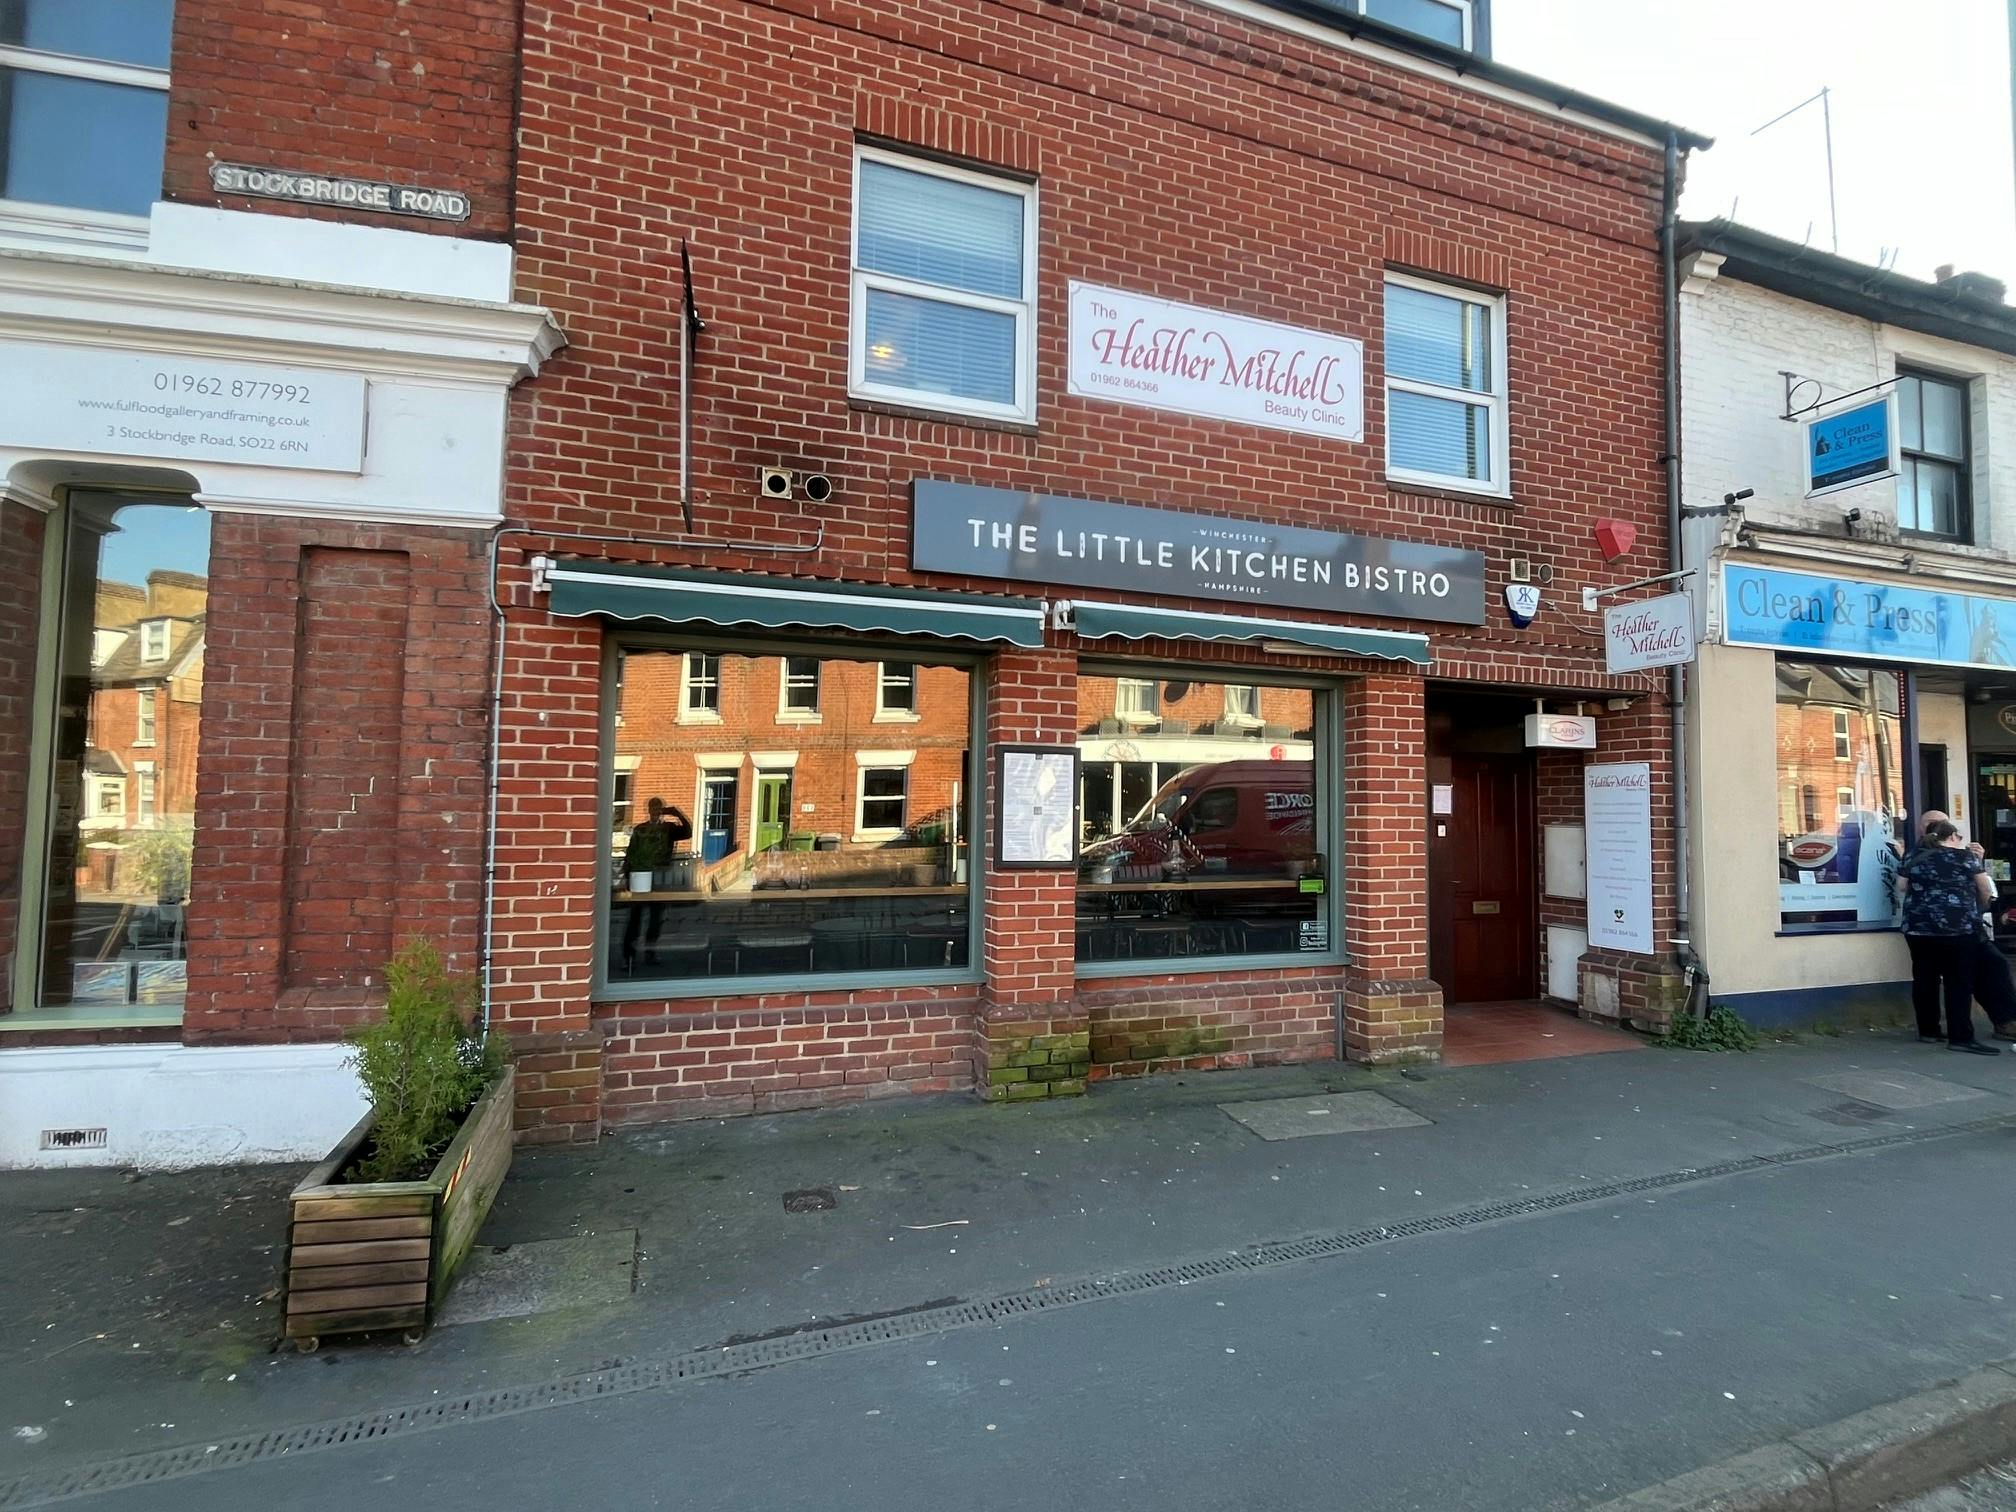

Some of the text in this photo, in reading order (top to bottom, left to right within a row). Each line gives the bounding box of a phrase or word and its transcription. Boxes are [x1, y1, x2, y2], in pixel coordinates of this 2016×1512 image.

[214, 168, 464, 216] STOCKBRIDGE ROAD
[1091, 302, 1118, 321] The
[1091, 318, 1345, 405] Heather Mitchell
[154, 372, 311, 404] 01962 877992
[1090, 373, 1159, 393] 01962 864366
[78, 399, 310, 427] www.fulfloodgalleryandframing.co.uk
[1264, 400, 1346, 426] Beauty Clinic
[106, 425, 115, 437] 3
[120, 426, 196, 446] Stockbridge
[239, 436, 275, 451] SO22
[279, 440, 309, 452] 6RN
[1833, 422, 1871, 440] Clean
[1834, 430, 1883, 452] & Press
[1199, 529, 1266, 544] WINCHESTER
[967, 518, 1450, 598] THE LITTLE KITCHEN BISTRO
[1203, 581, 1262, 595] HAMPSHIRE
[1737, 577, 1937, 635] Clean & Press
[1612, 611, 1660, 638] Heather
[1623, 625, 1686, 655] Mitchell
[1550, 726, 1585, 736] CLARINS
